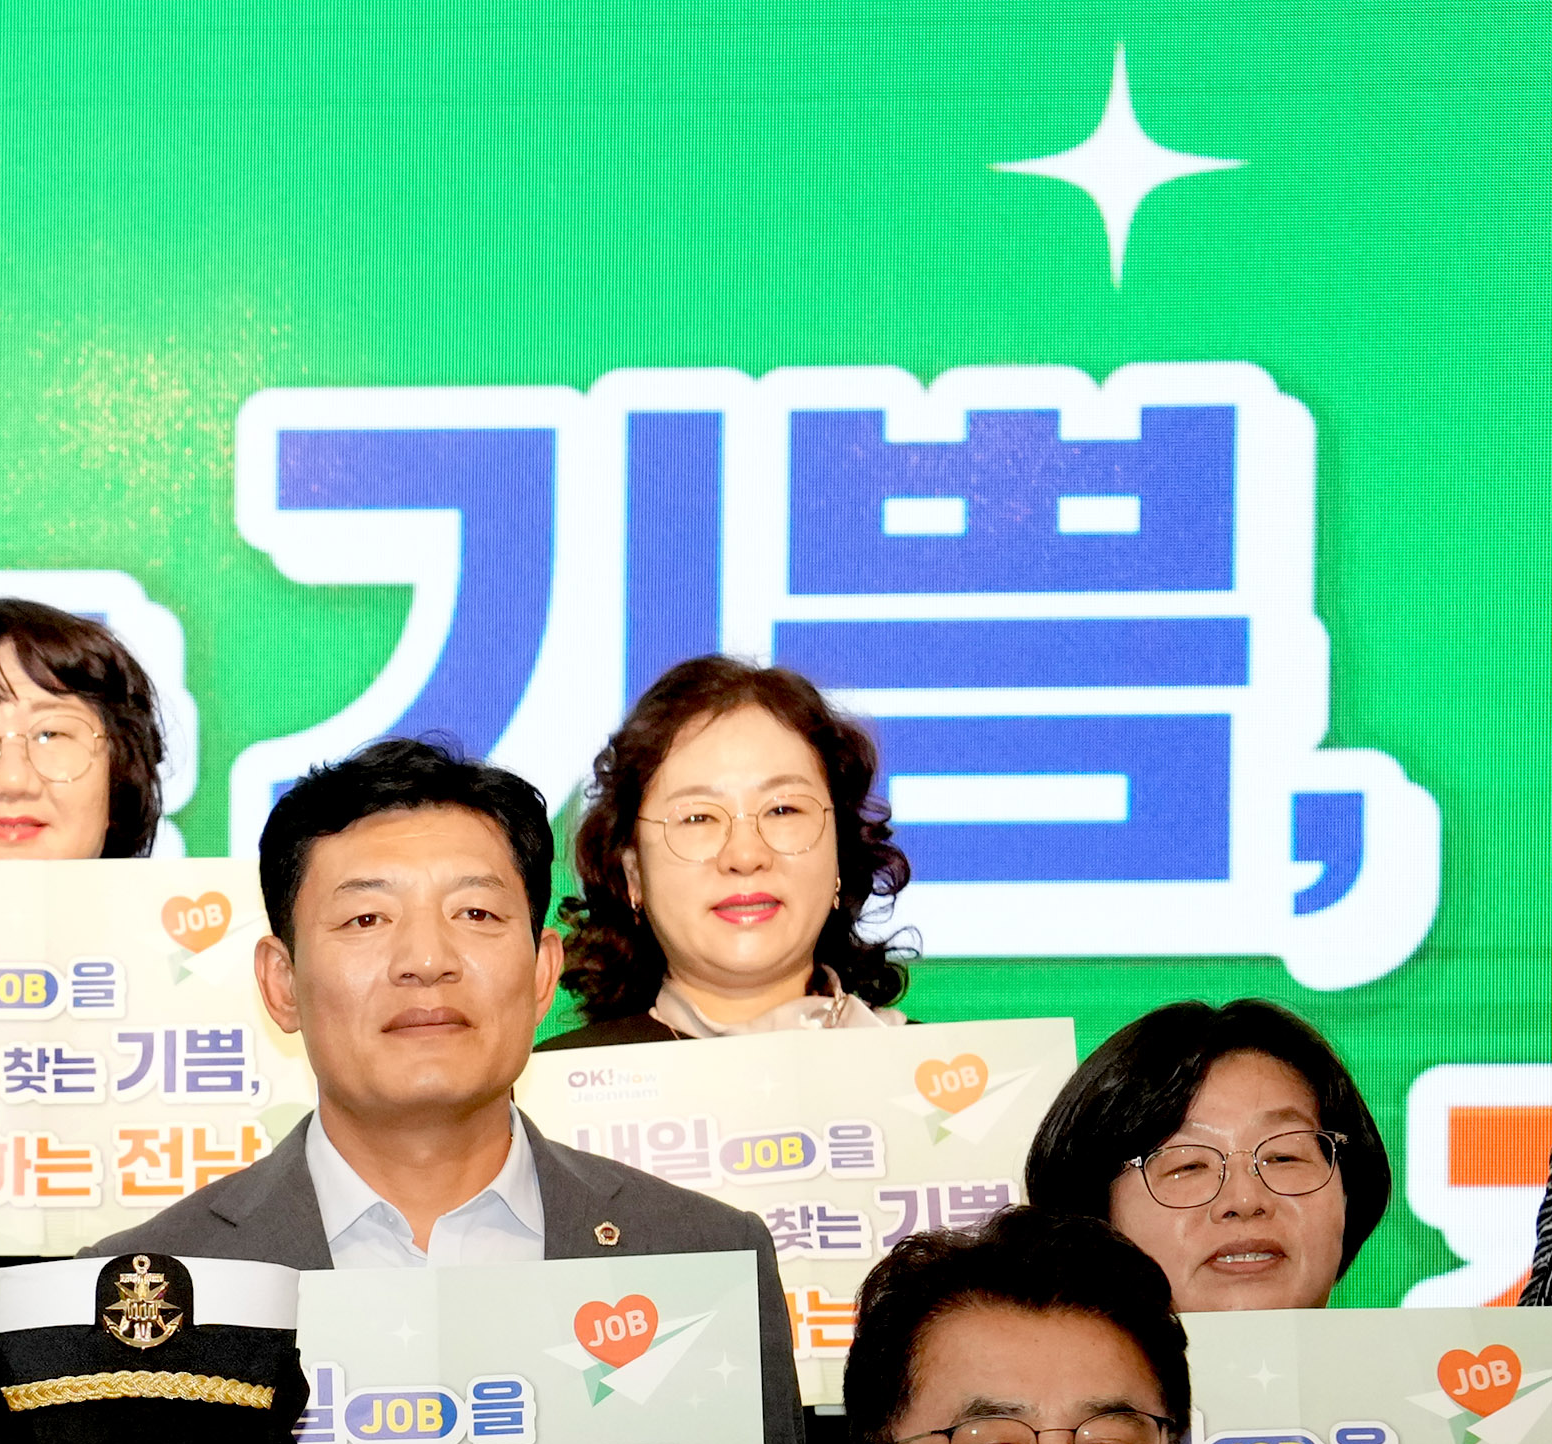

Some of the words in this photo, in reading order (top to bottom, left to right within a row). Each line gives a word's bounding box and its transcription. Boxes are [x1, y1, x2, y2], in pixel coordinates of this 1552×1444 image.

[276, 404, 1364, 916] 기쁨,
[172, 904, 223, 936] JOB
[72, 962, 115, 1008] 을
[4, 1048, 96, 1094] 찾는
[117, 1029, 260, 1096] 기쁨,
[928, 1066, 979, 1096] JOB
[733, 1137, 805, 1169] JOB
[829, 1124, 875, 1169] 을
[766, 1207, 862, 1250] 찾는
[589, 1308, 648, 1348] JOB
[1452, 1360, 1513, 1396] JOB
[360, 1398, 443, 1434] JOB
[471, 1380, 525, 1436] 을
